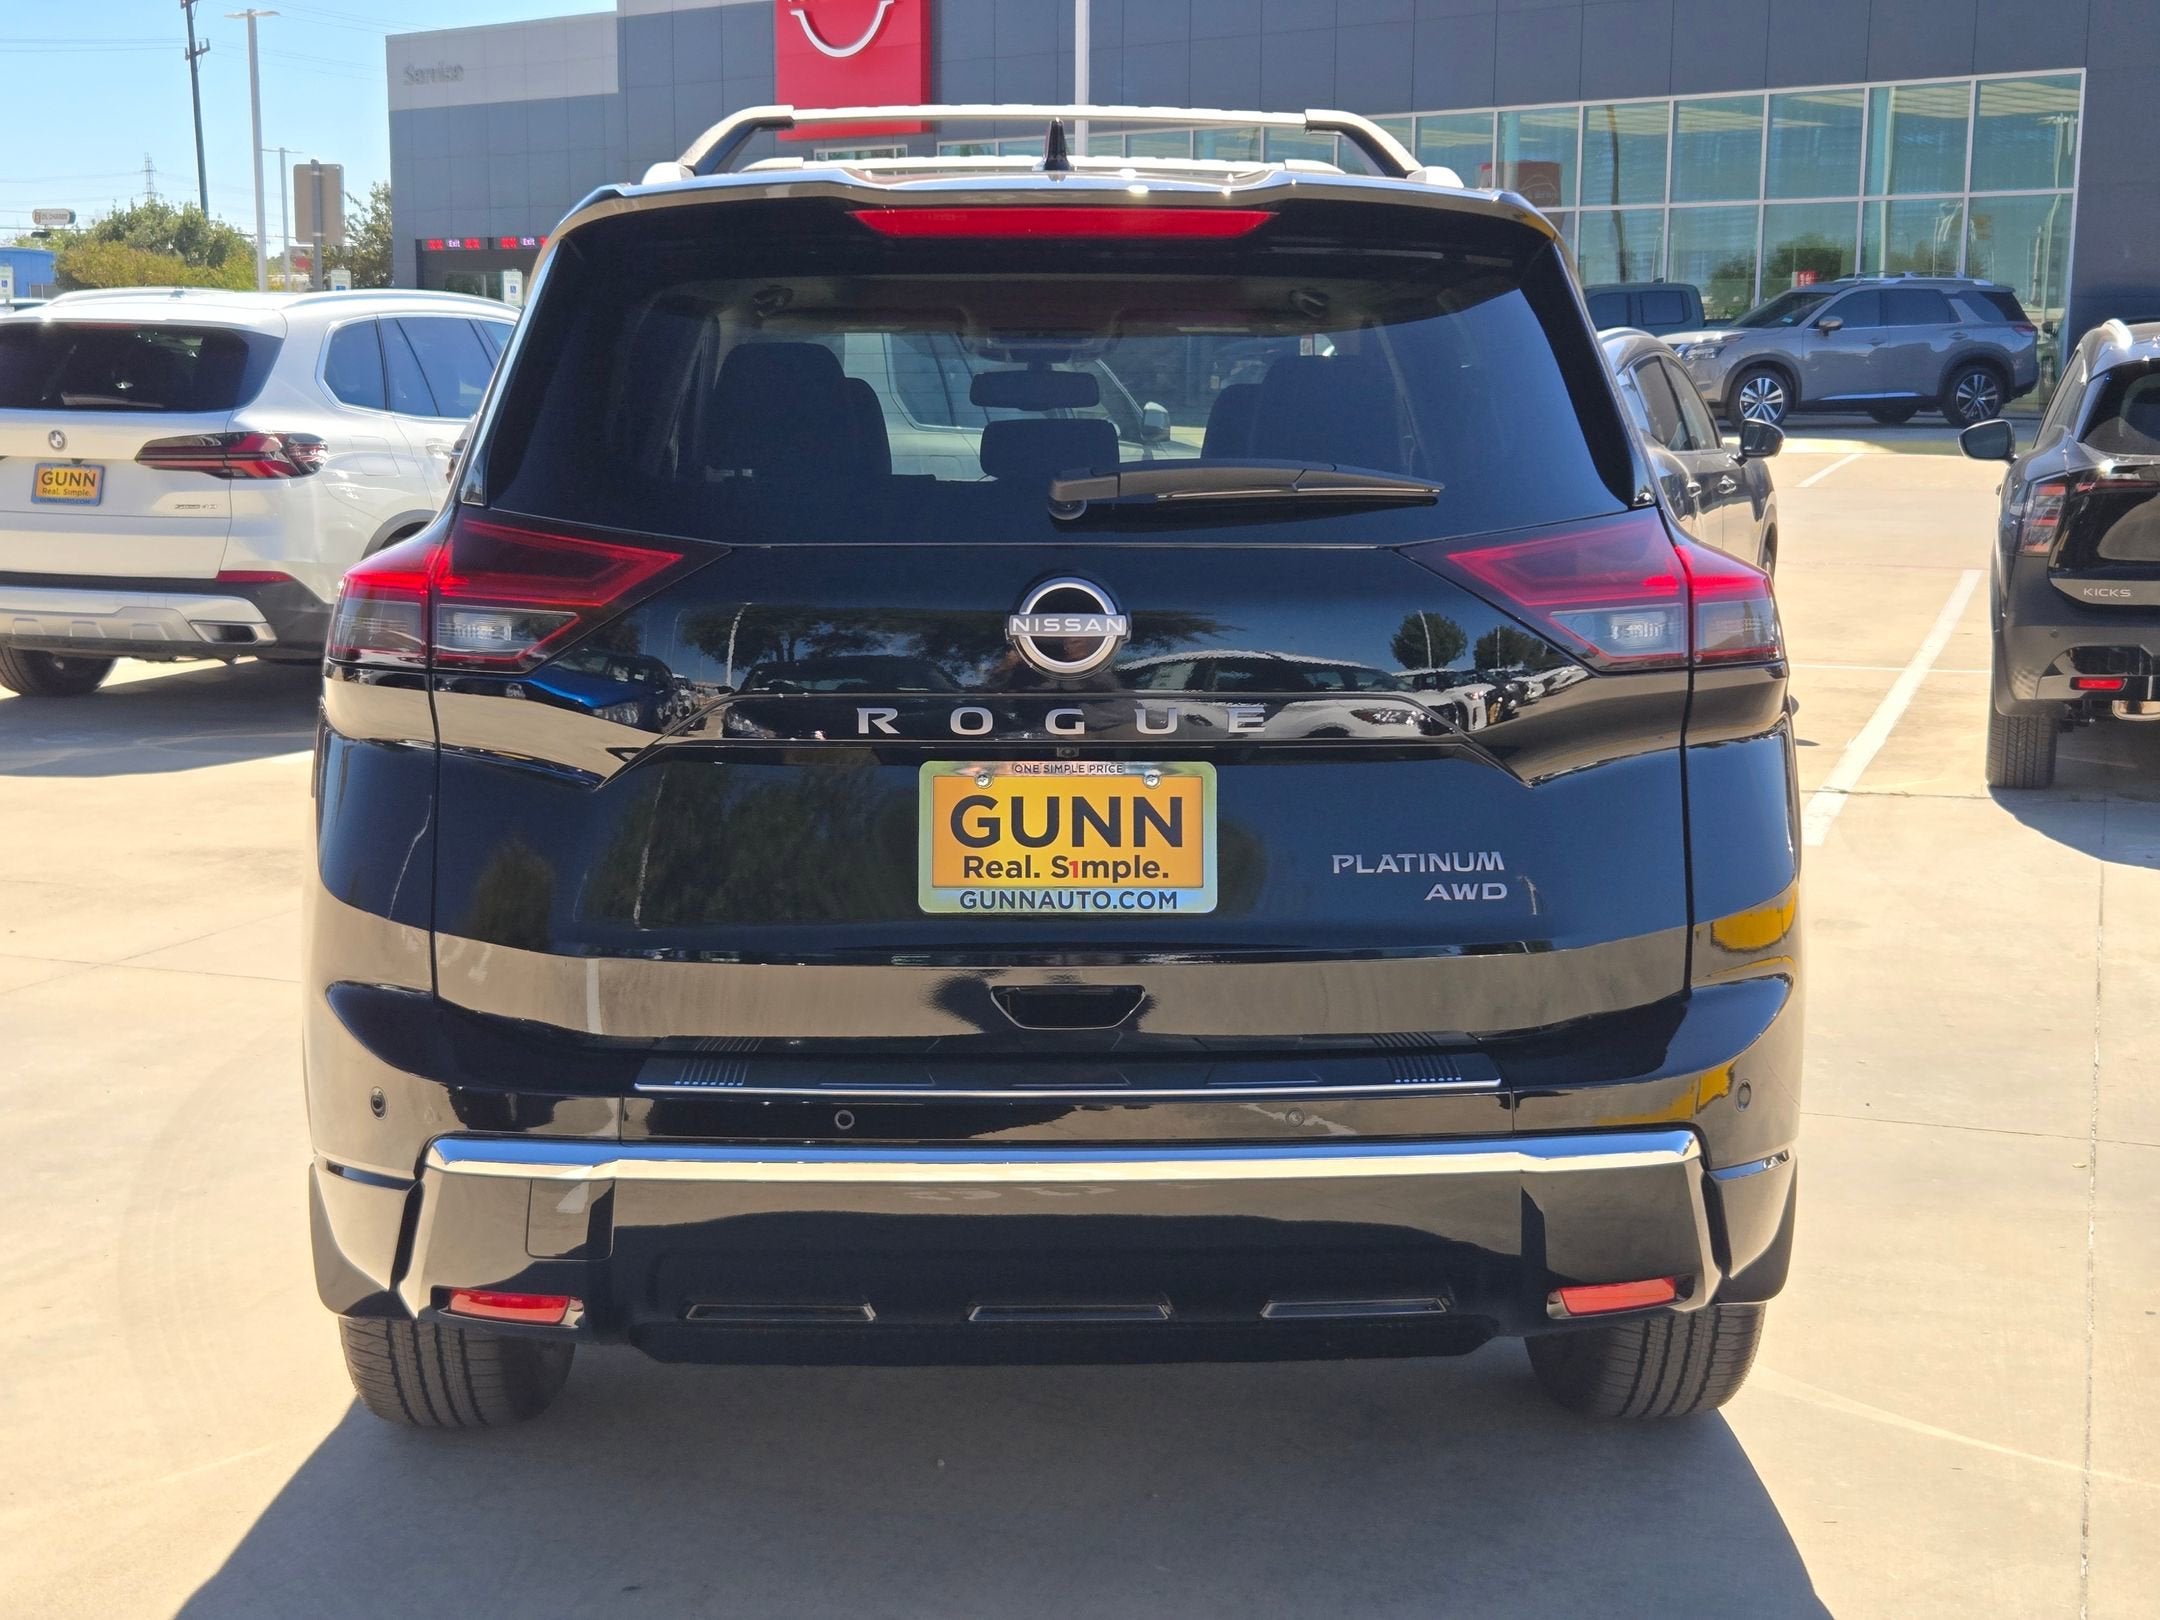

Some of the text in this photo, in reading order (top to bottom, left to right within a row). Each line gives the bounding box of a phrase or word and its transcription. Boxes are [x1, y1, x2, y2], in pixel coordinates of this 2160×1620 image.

[448, 239, 461, 248] Exit
[522, 237, 536, 246] Exit
[41, 470, 97, 487] GUNN
[42, 487, 60, 496] Real.
[2083, 587, 2132, 598] KICKS
[1012, 618, 1123, 632] NISSAN
[856, 705, 1267, 735] ROGUE
[1014, 764, 1123, 774] ONE SIMPLE PRICE
[950, 795, 1183, 849] GUNN
[963, 855, 1041, 879] Real.
[1332, 851, 1505, 874] PLATINUM
[959, 891, 1177, 910] GUNNAUTO.COM
[1424, 883, 1508, 901] AWD
